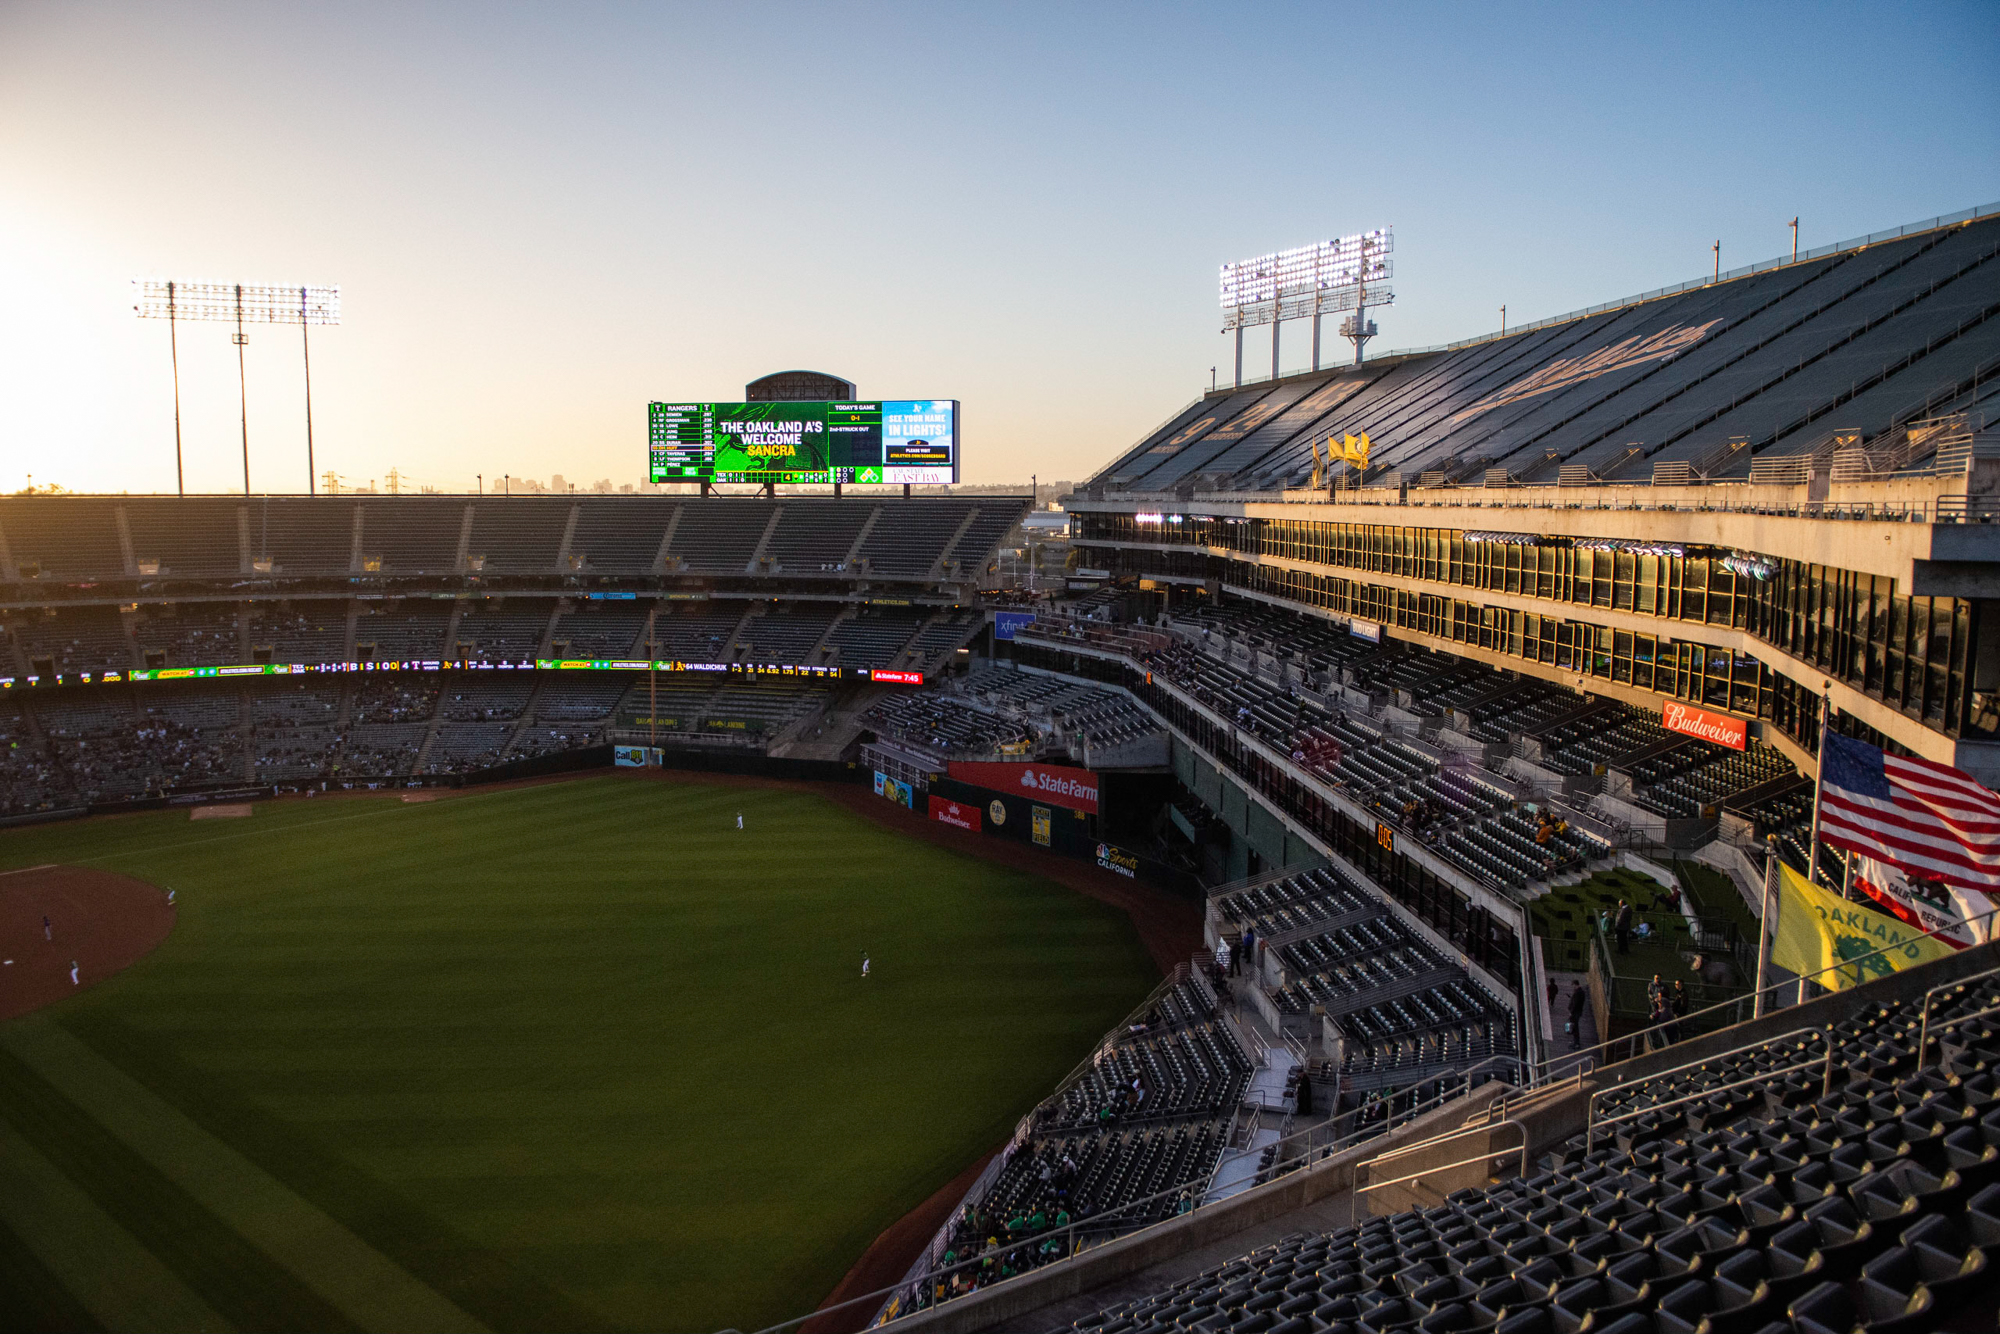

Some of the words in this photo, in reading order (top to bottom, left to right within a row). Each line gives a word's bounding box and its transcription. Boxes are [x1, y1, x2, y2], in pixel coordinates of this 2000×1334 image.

[1299, 381, 1365, 410] 43
[1219, 402, 1288, 431] 24
[720, 422, 744, 433] THE
[746, 422, 802, 433] OAKLAND
[805, 422, 823, 432] A'S
[889, 425, 901, 436] IN
[903, 425, 946, 436] LIGHTS!
[1169, 417, 1216, 445] 9
[741, 433, 802, 445] WELCOME
[747, 445, 796, 456] SANCRA
[1353, 623, 1362, 634] BUD
[1363, 625, 1376, 638] LIGHT
[411, 661, 420, 670] T
[1666, 703, 1742, 745] Budweiser
[616, 751, 630, 759] Call
[992, 804, 1002, 813] RAY
[938, 811, 971, 829] Budweiser
[1074, 810, 1085, 820] 388
[1033, 833, 1049, 844] FIELD
[1109, 847, 1138, 869] Sports
[1097, 858, 1135, 878] CALIFORNIA
